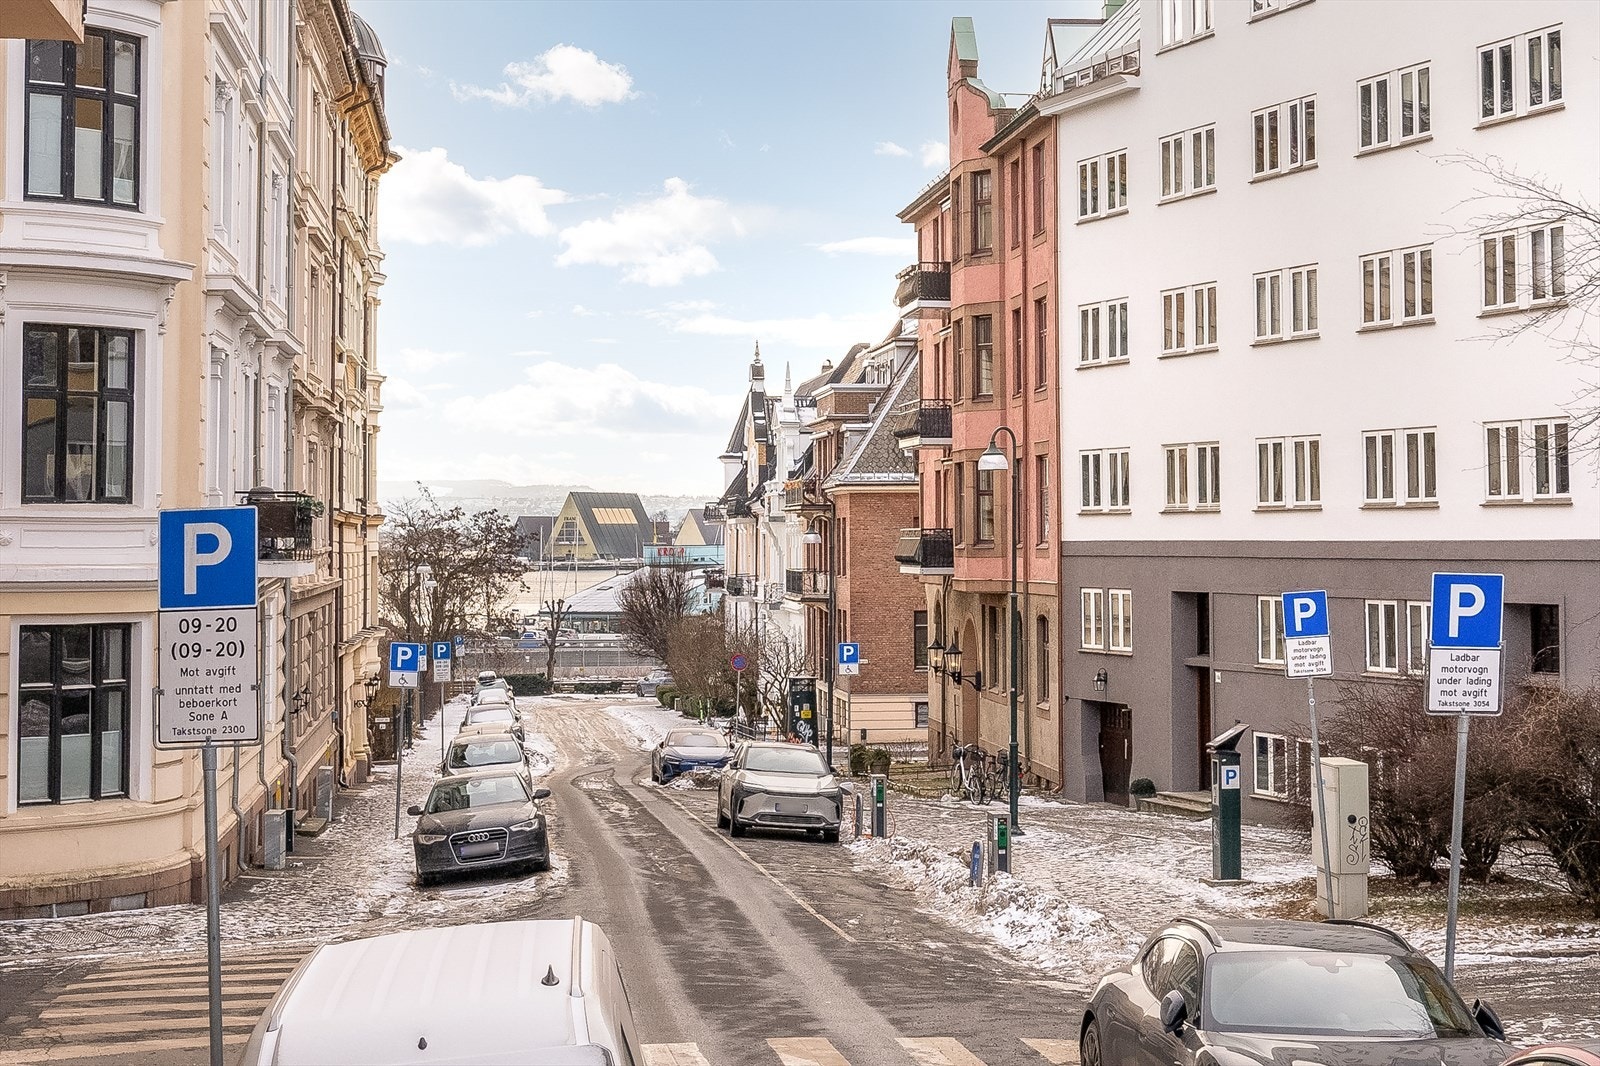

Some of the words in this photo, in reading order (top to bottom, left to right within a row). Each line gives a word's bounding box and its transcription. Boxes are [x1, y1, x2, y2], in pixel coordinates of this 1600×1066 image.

[184, 522, 233, 595] P
[1293, 597, 1317, 632] P
[1449, 583, 1486, 638] P
[397, 646, 413, 668] P
[437, 644, 447, 658] P
[843, 645, 854, 662] P
[1450, 653, 1480, 662] Ladbar
[180, 667, 200, 677] Mot
[205, 665, 237, 679] avgift
[1441, 665, 1489, 675] motorvogn
[1437, 676, 1462, 685] under
[1466, 676, 1492, 687] lading
[175, 684, 214, 696] unntatt
[219, 683, 242, 694] med
[1440, 688, 1458, 697] mot
[1461, 688, 1488, 700] avgift
[179, 697, 238, 709] beboerkort
[1438, 700, 1470, 708] Takstsone
[188, 711, 215, 722] Sone
[220, 710, 229, 721] A
[171, 726, 218, 737] Takstsone
[221, 725, 246, 734] 2300
[1226, 769, 1237, 786] P
